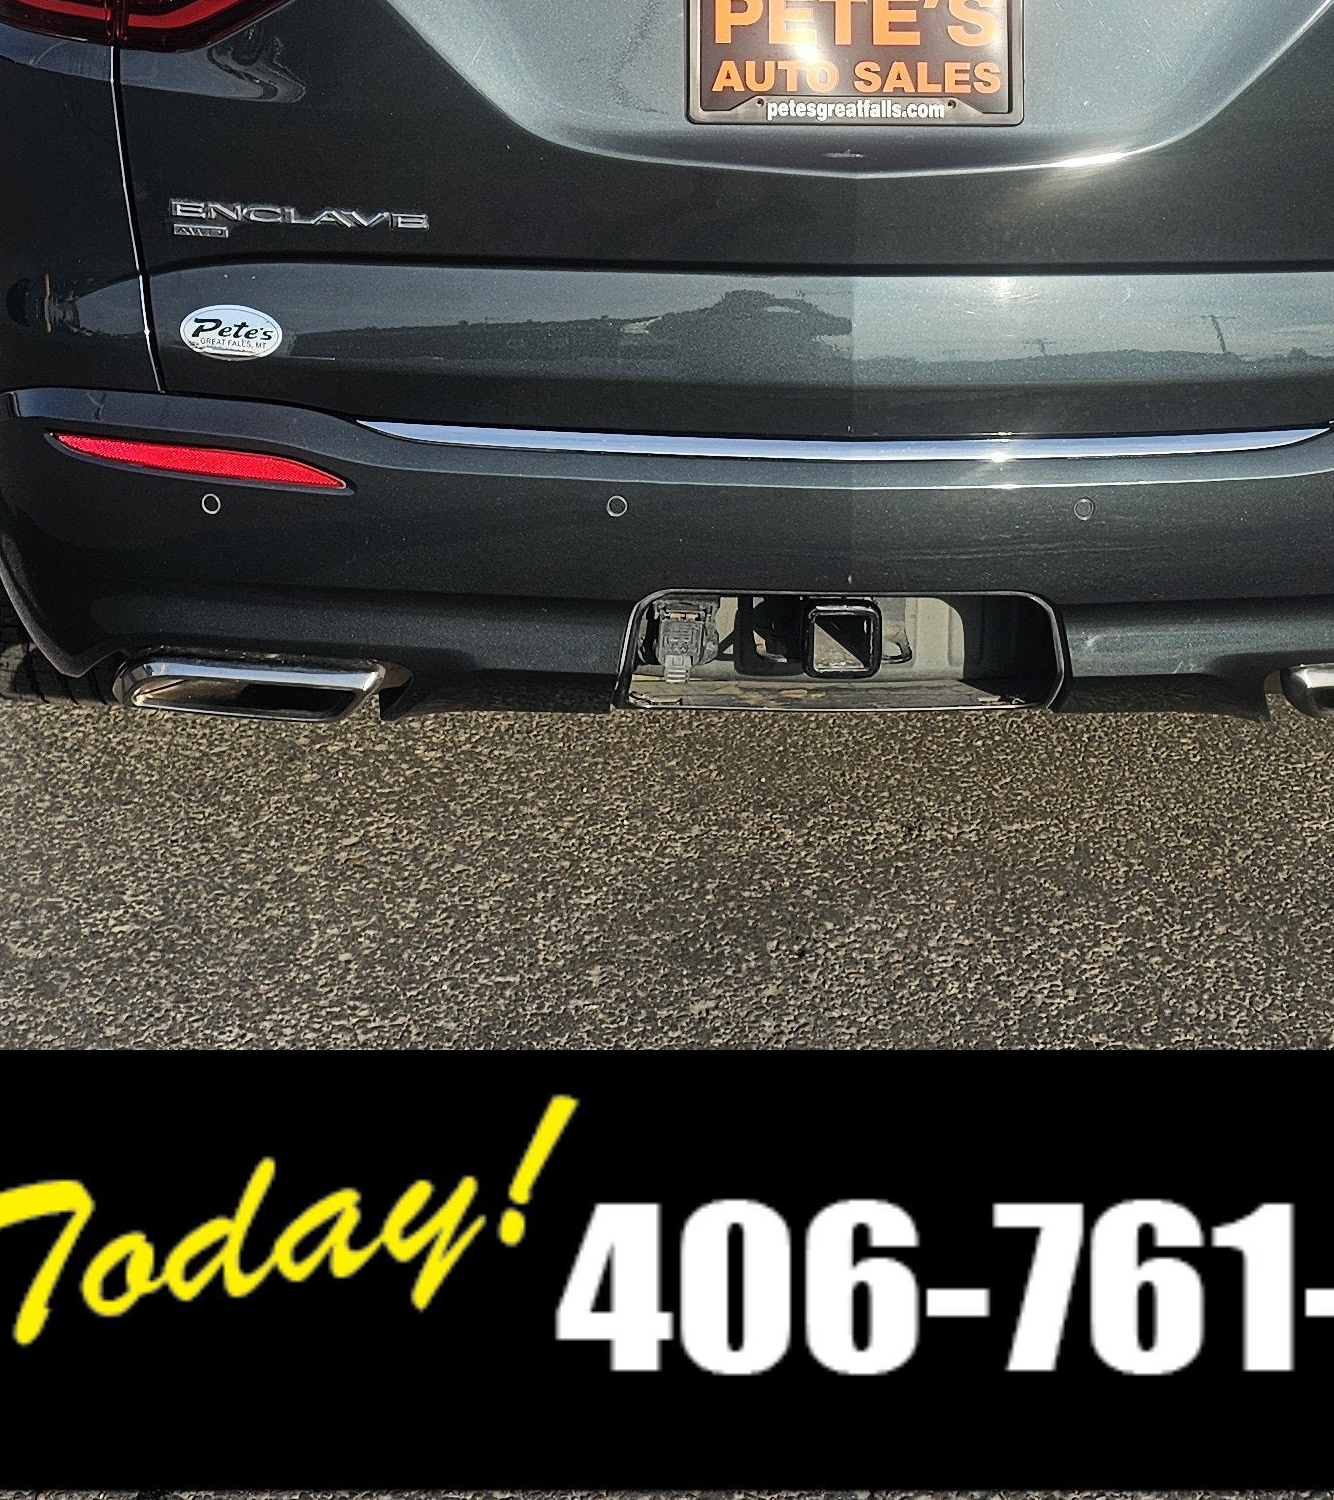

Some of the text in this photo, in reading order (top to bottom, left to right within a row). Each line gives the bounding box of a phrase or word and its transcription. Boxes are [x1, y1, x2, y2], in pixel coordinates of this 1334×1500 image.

[712, 60, 1001, 94] AUTO SALES
[767, 99, 945, 122] petesgreatfalls.com
[170, 199, 430, 231] ENCLAVE
[192, 317, 274, 341] Pete's
